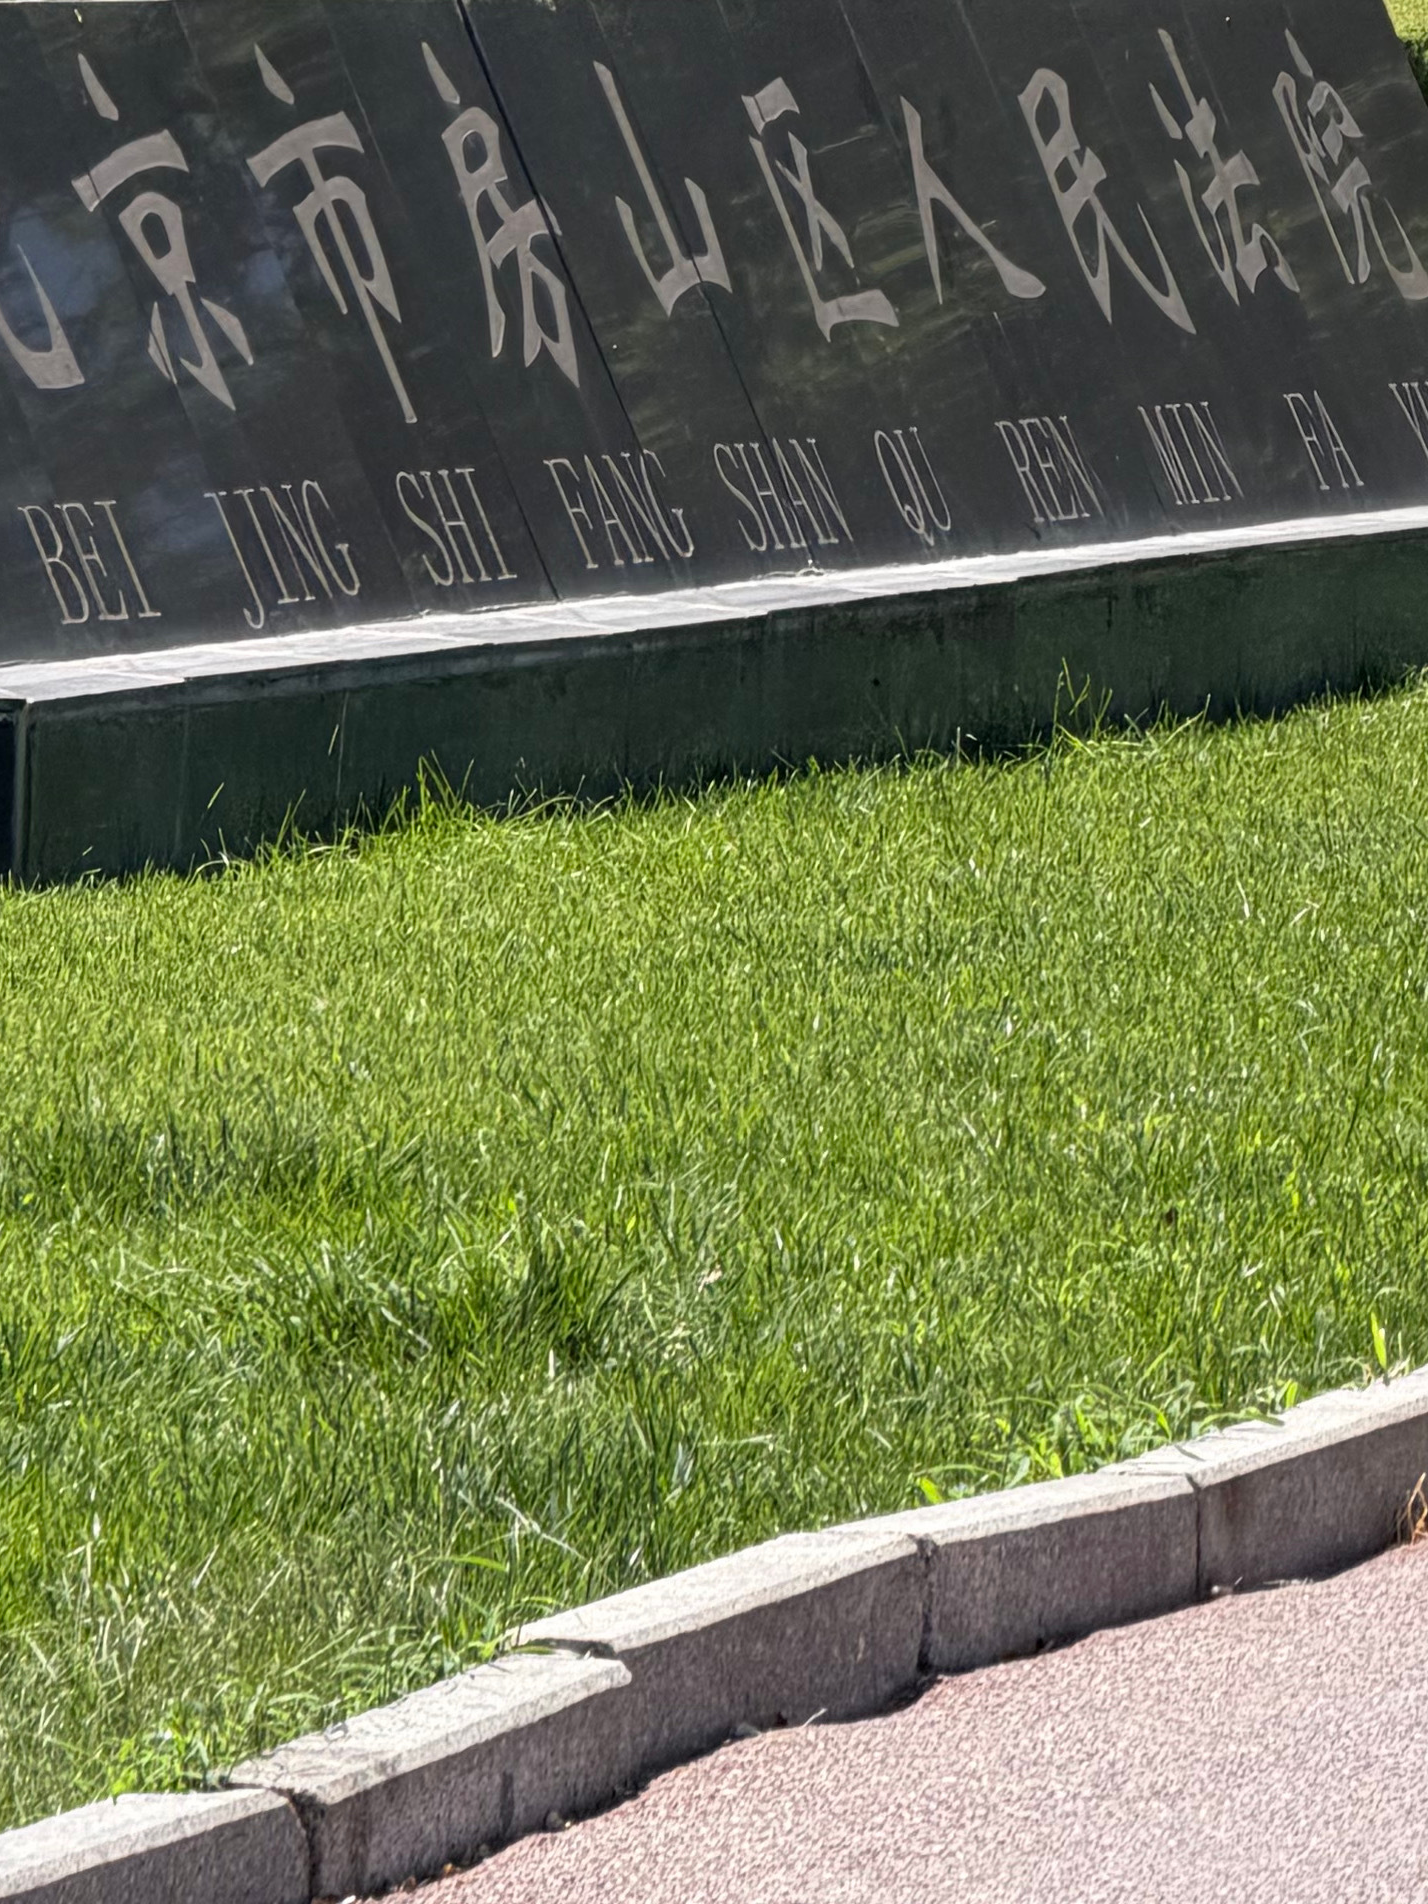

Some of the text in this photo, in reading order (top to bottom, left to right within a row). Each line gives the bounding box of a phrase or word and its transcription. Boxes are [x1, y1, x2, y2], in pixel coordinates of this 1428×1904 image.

[17, 499, 162, 625] BEI
[203, 478, 360, 630] JING
[395, 467, 518, 587] SHI
[542, 448, 695, 569] FANG
[713, 436, 855, 552] SHAN
[874, 426, 952, 547] QU
[994, 414, 1106, 523] REN
[1137, 400, 1244, 506] MIN
[1283, 390, 1365, 491] FA
